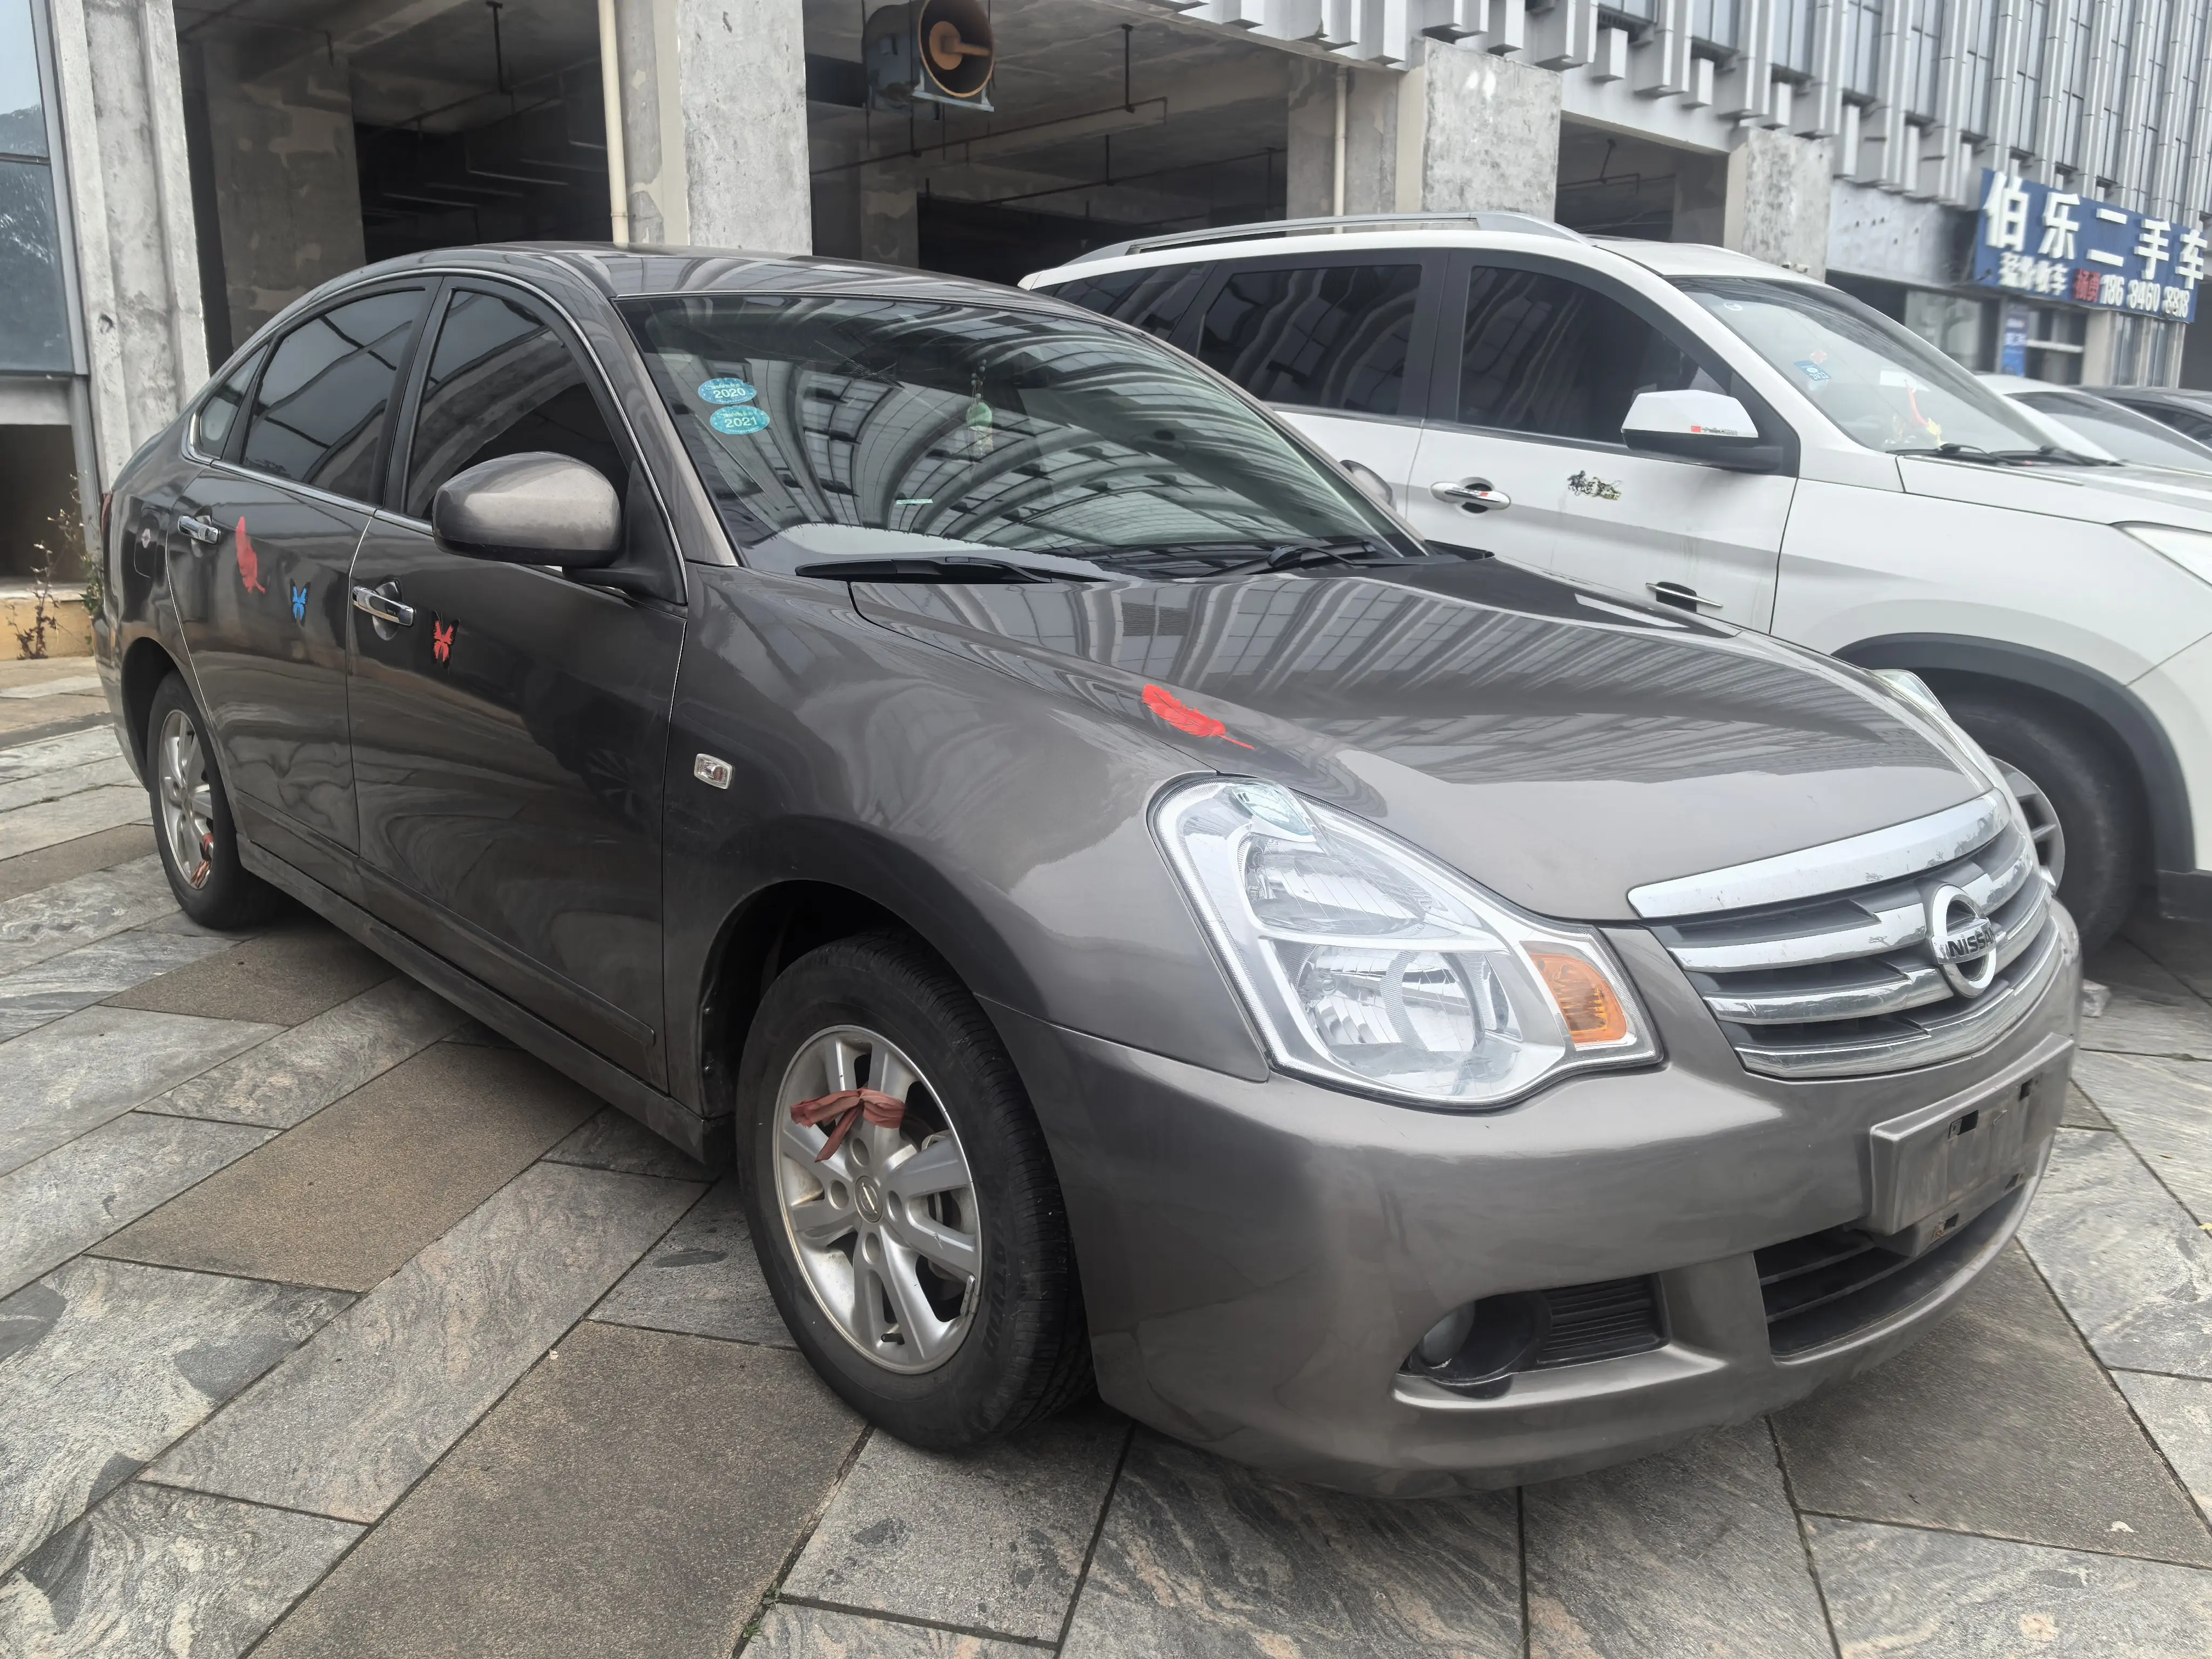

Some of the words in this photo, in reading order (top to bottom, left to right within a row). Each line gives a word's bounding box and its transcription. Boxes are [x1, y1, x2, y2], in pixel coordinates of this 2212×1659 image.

[1983, 171, 2208, 290] 伯乐二手车
[2100, 274, 2125, 306] 186
[2127, 279, 2160, 312] 8460
[713, 388, 746, 399] 2020
[724, 416, 758, 428] 2021
